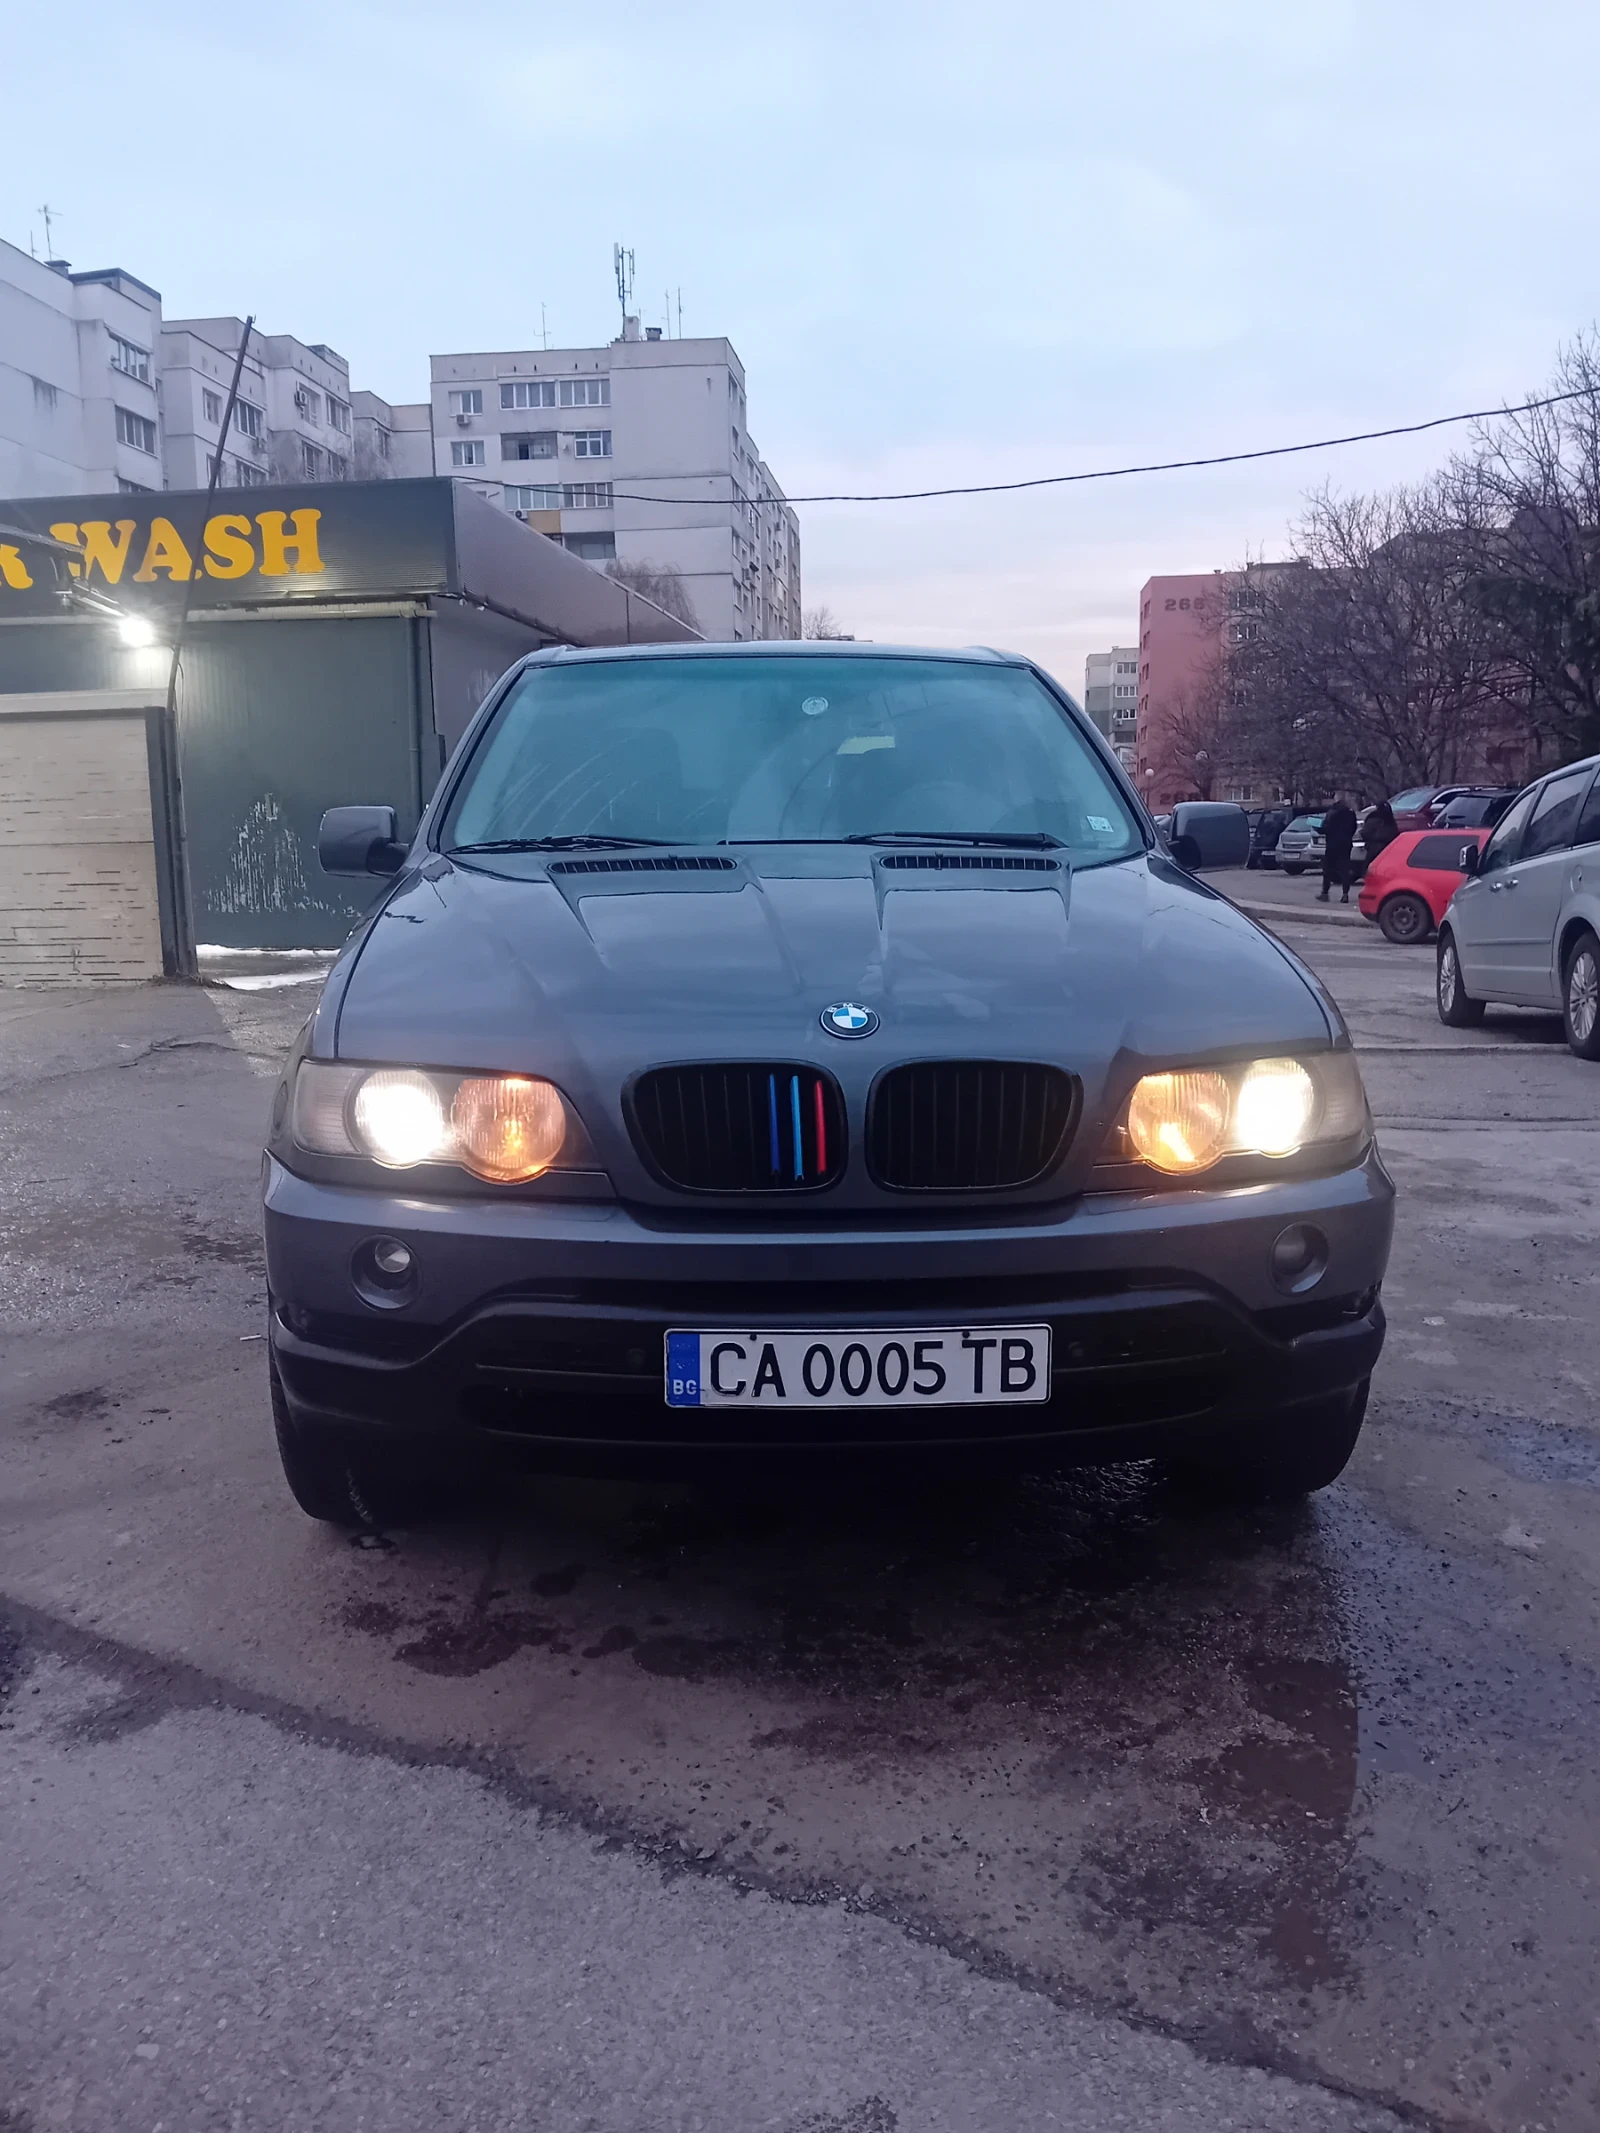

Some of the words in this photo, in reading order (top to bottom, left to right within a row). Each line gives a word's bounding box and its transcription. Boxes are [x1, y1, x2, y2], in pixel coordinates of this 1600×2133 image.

[49, 508, 326, 584] WASH
[672, 1379, 697, 1396] BG
[710, 1342, 787, 1398] CA
[802, 1340, 947, 1398] 0005
[961, 1338, 1037, 1394] TB
